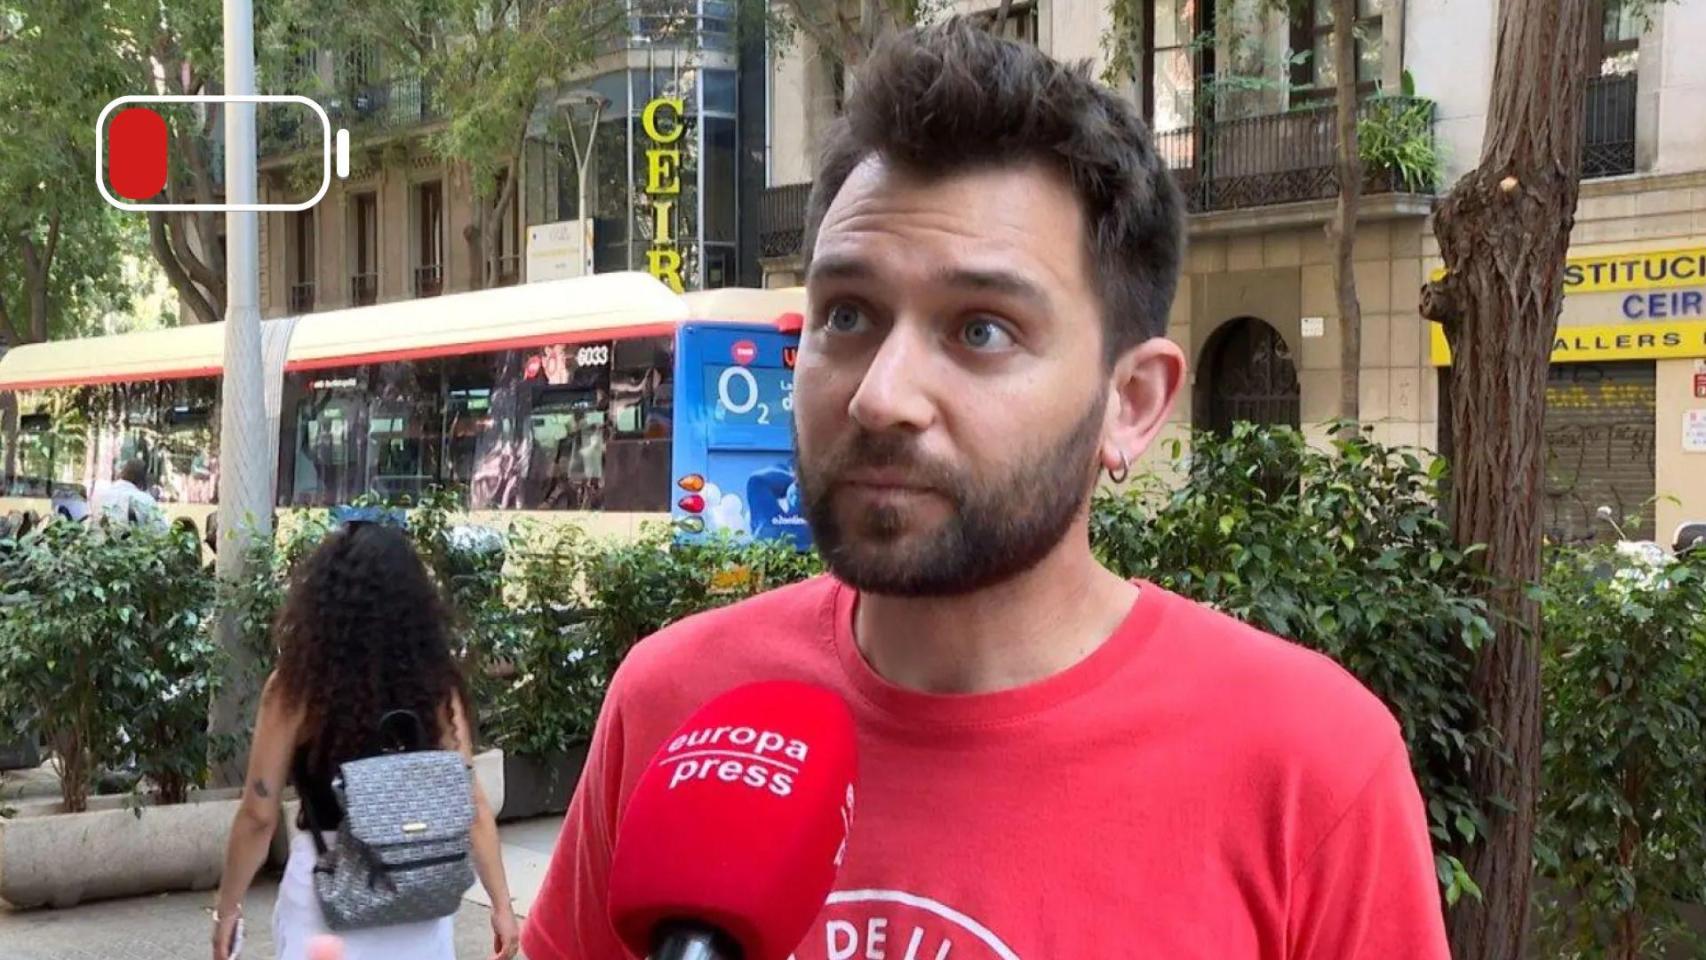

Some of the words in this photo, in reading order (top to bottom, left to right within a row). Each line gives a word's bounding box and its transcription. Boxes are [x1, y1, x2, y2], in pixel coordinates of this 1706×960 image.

[642, 98, 686, 295] CEIR
[1563, 255, 1706, 286] STITUCI
[1622, 291, 1703, 319] CEIR
[577, 345, 609, 367] 6033
[1552, 332, 1681, 351] ALLERS
[667, 725, 809, 762] europa
[668, 758, 794, 797] press
[826, 918, 888, 960] DE
